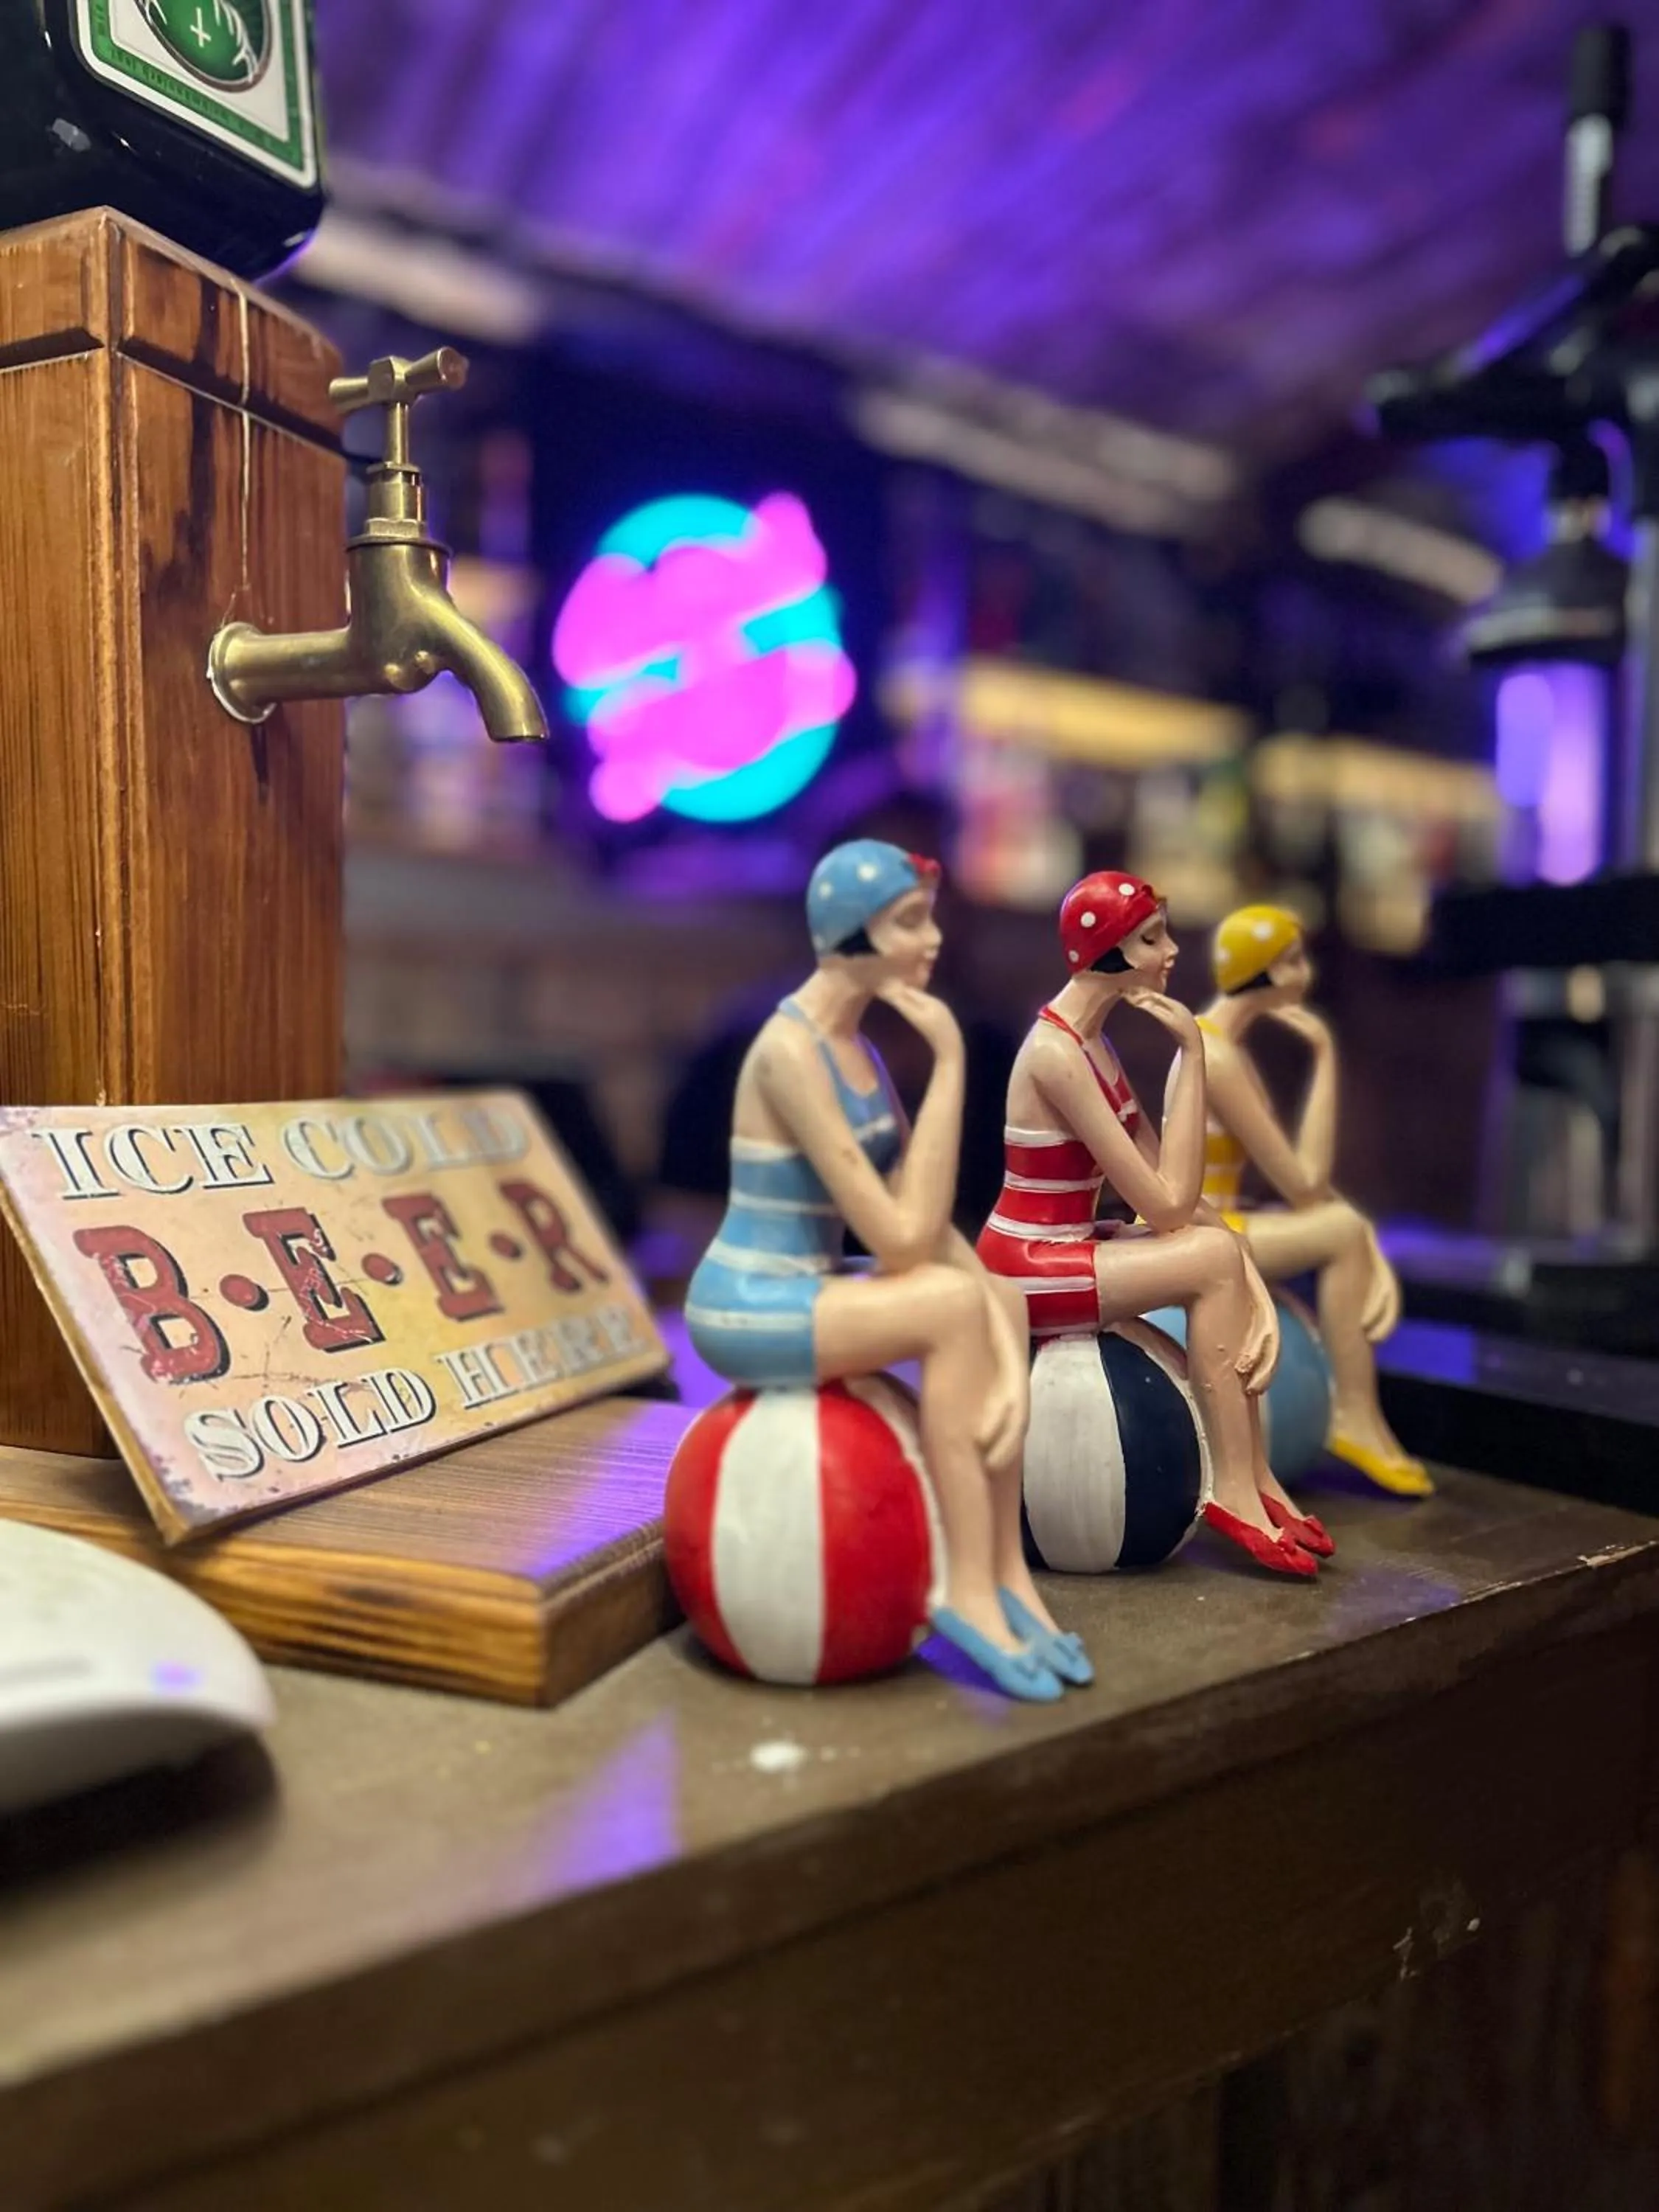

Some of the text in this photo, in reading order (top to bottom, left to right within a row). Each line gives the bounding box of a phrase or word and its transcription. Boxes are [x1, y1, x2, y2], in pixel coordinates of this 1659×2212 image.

[31, 1107, 529, 1201] ICE COLD
[184, 1305, 649, 1482] SOLD HERE
